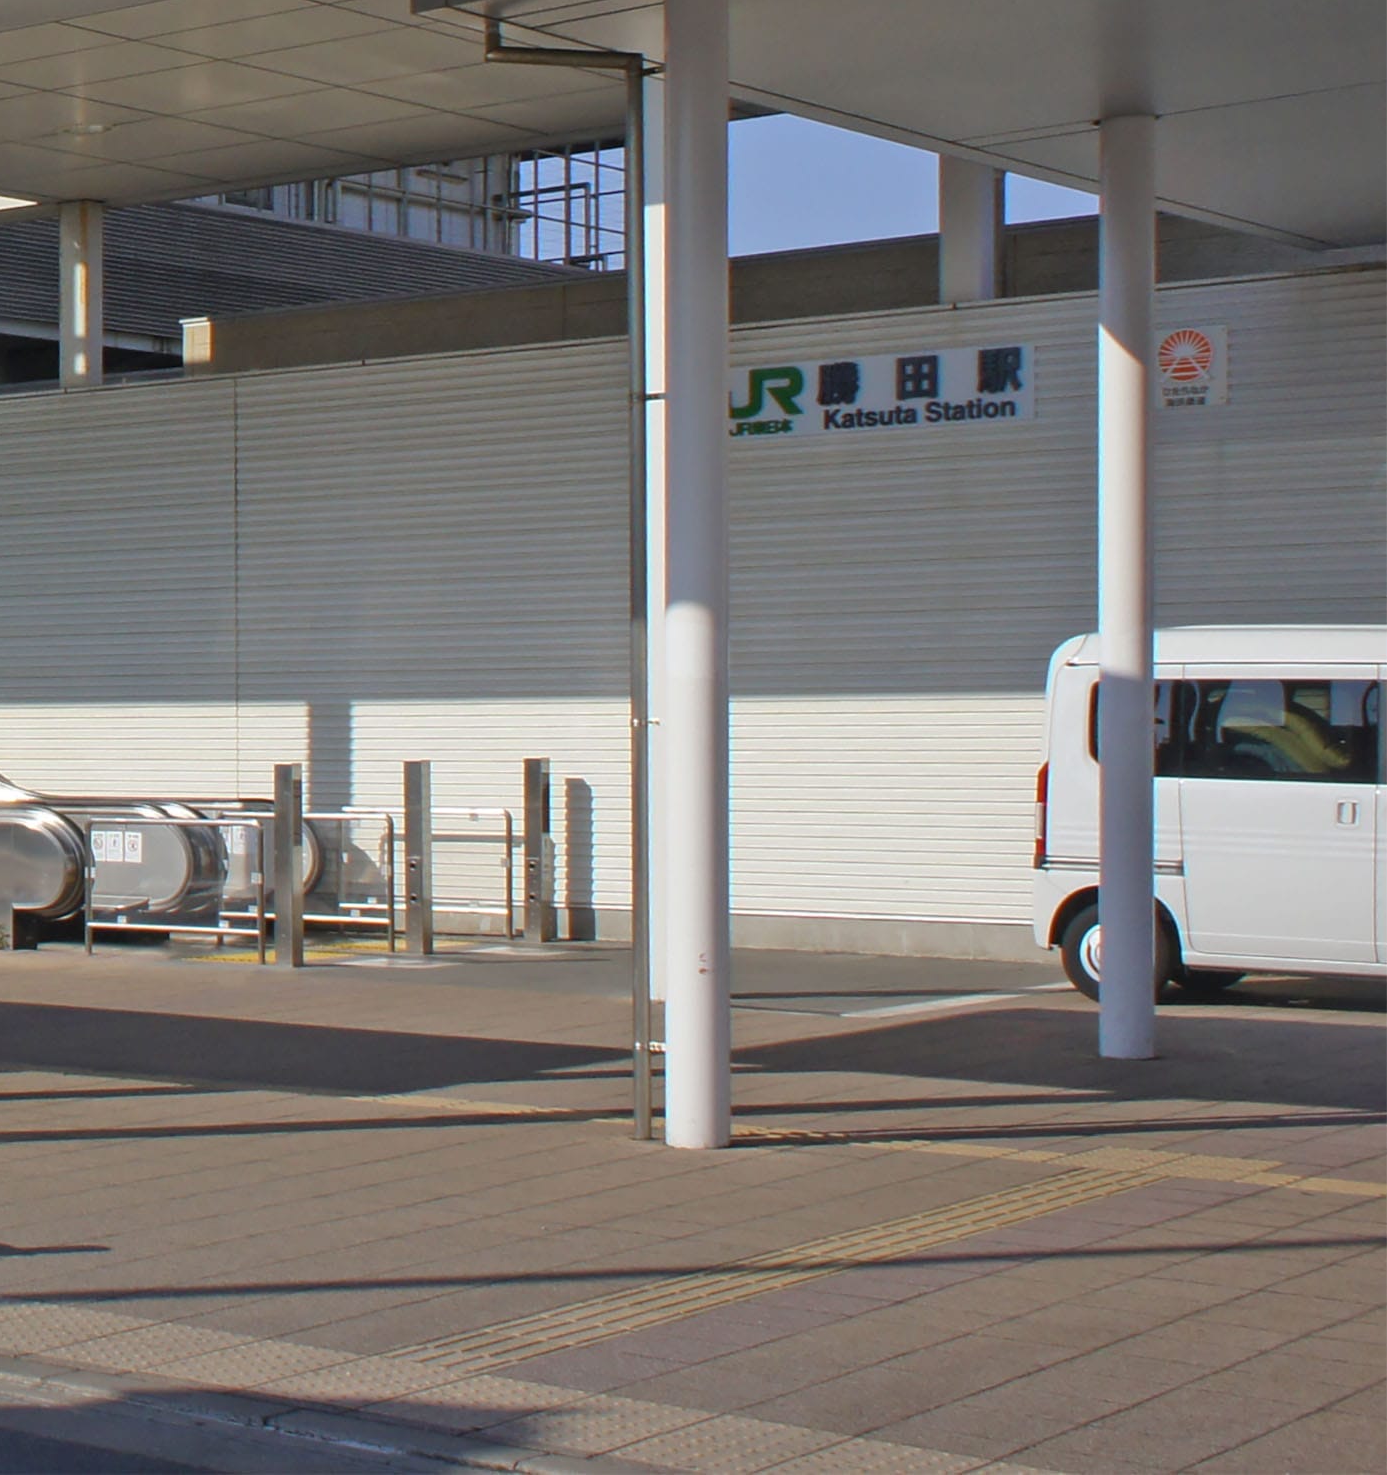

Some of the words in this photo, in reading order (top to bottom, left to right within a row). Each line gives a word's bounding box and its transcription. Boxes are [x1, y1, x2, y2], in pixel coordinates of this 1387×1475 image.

[729, 366, 804, 419] JR
[817, 347, 1022, 406] 勝田駅
[823, 405, 917, 430] Katsuta
[924, 398, 1016, 423] Station
